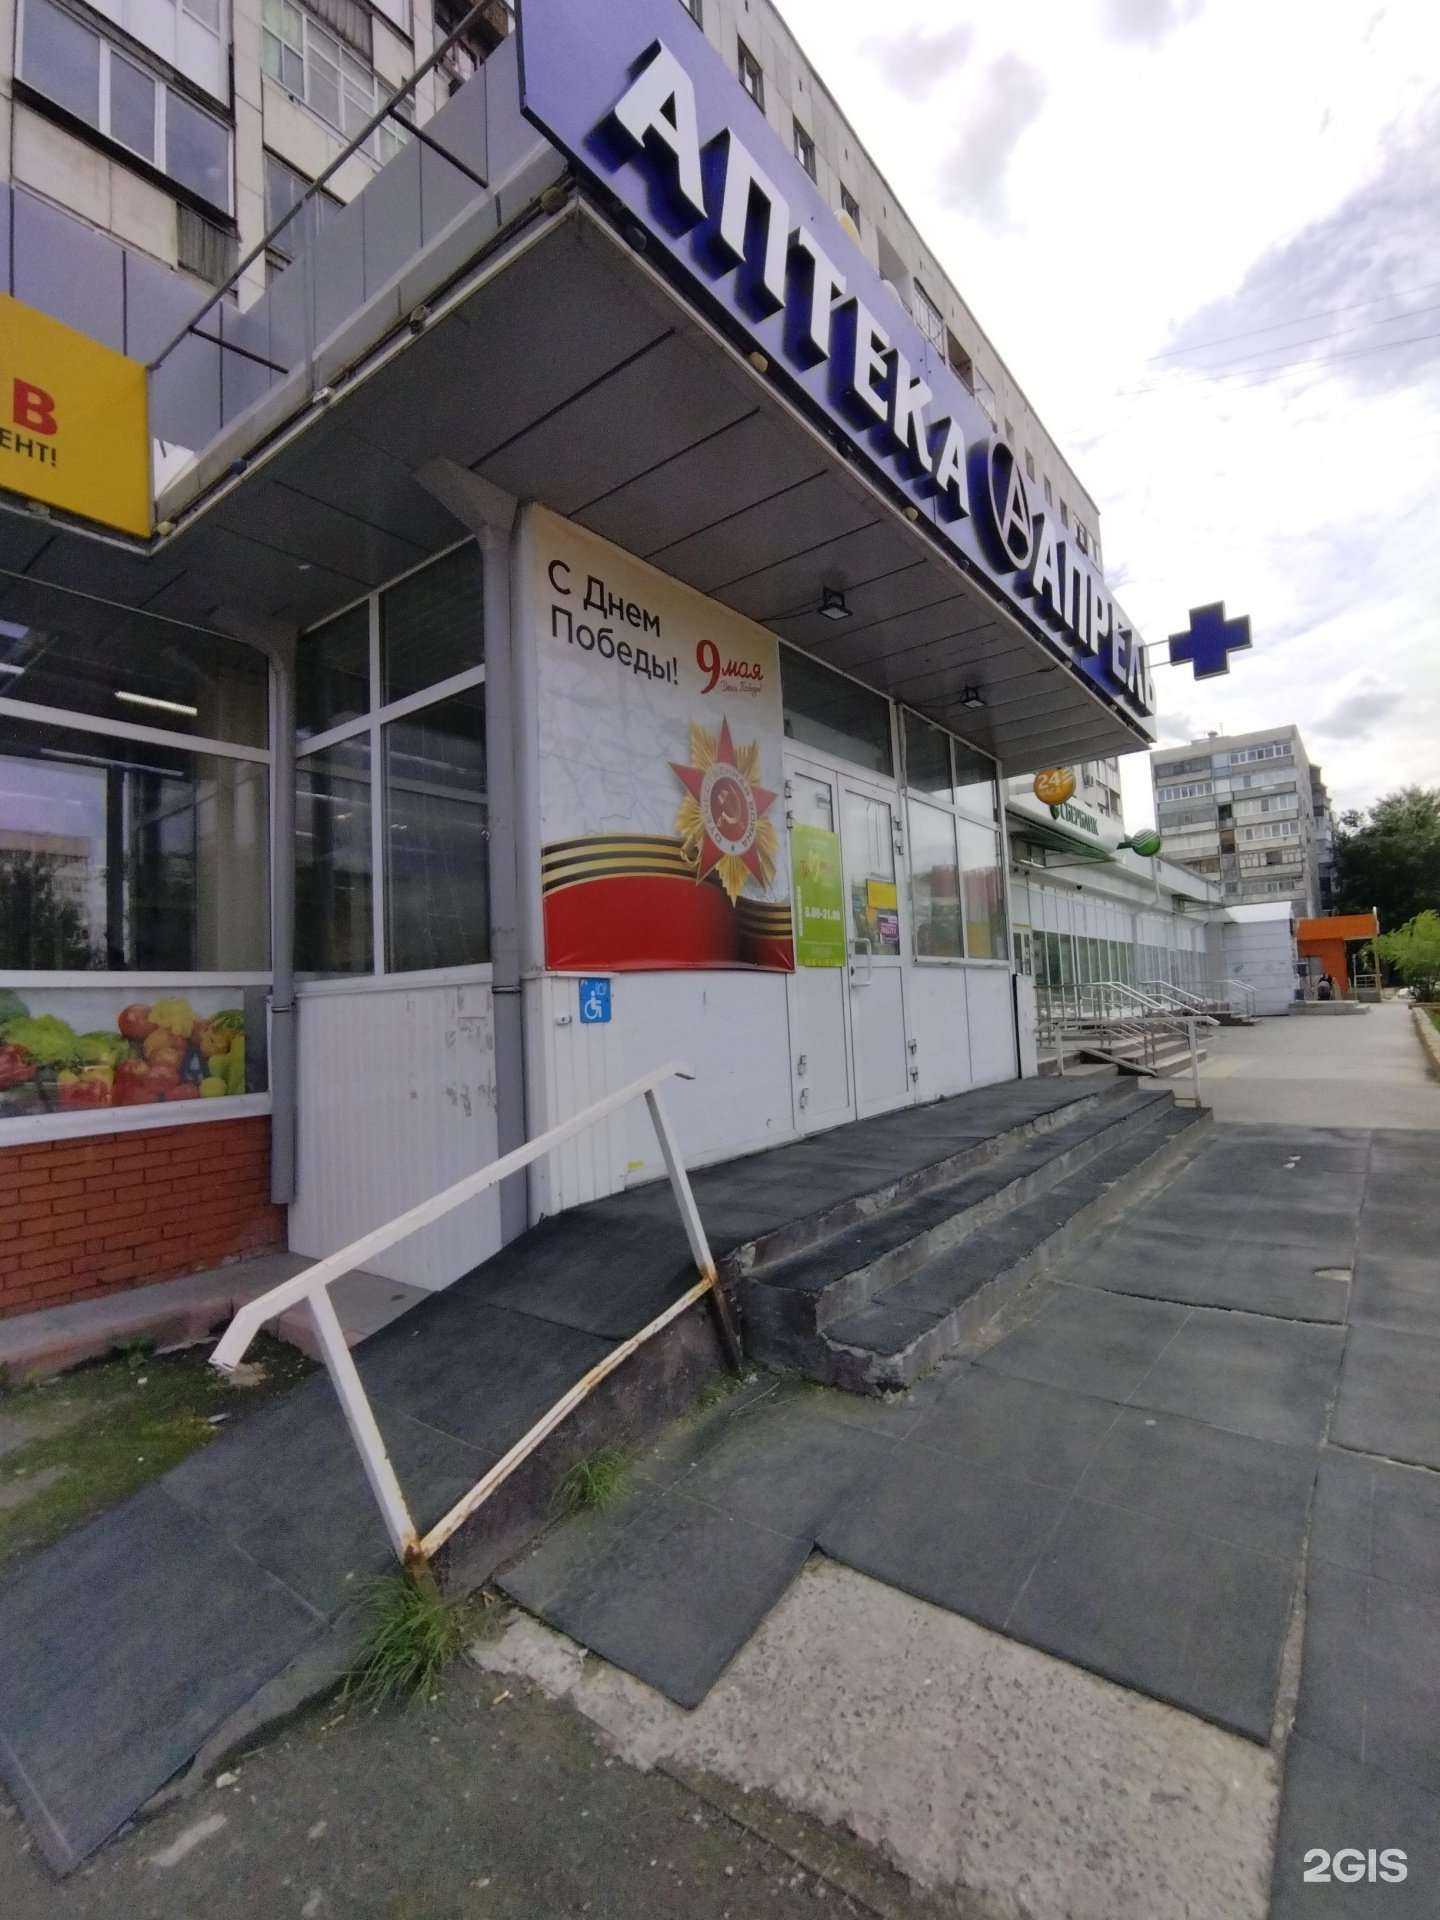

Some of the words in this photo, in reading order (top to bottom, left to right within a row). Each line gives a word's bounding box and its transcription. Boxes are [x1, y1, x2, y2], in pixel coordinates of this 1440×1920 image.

[13, 377, 58, 436] В
[614, 38, 969, 517] АПТЕКА
[1033, 512, 1156, 716] АПРЕЛЬ
[0, 426, 57, 467] ЕНТ!
[547, 559, 571, 595] С
[583, 575, 661, 638] Днем
[551, 604, 679, 686] Победы!
[696, 640, 721, 694] 9
[721, 658, 764, 681] мая
[1061, 803, 1099, 836] СБЕРБАНК
